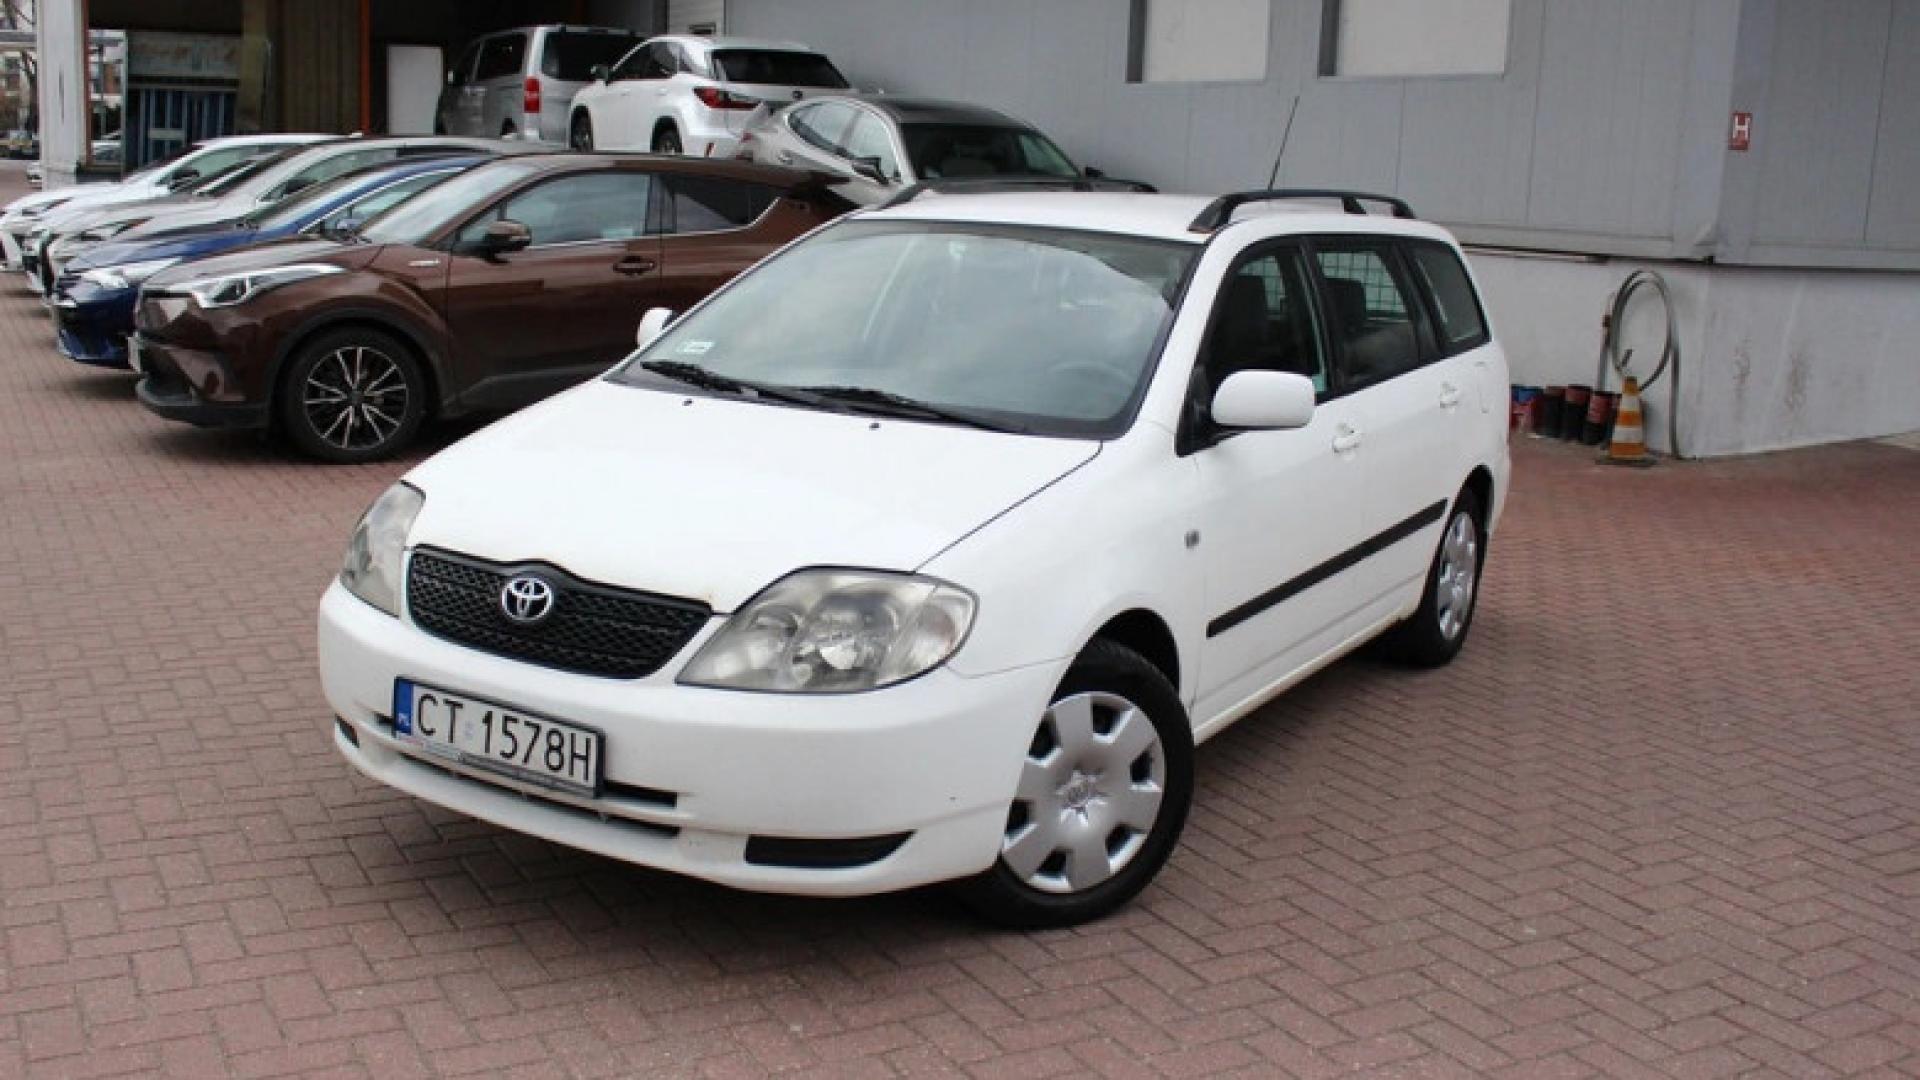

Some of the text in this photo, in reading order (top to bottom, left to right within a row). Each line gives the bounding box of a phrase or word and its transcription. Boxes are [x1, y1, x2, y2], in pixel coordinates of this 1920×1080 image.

[1733, 114, 1750, 140] H
[418, 693, 463, 743] CT
[482, 710, 591, 781] 1578H
